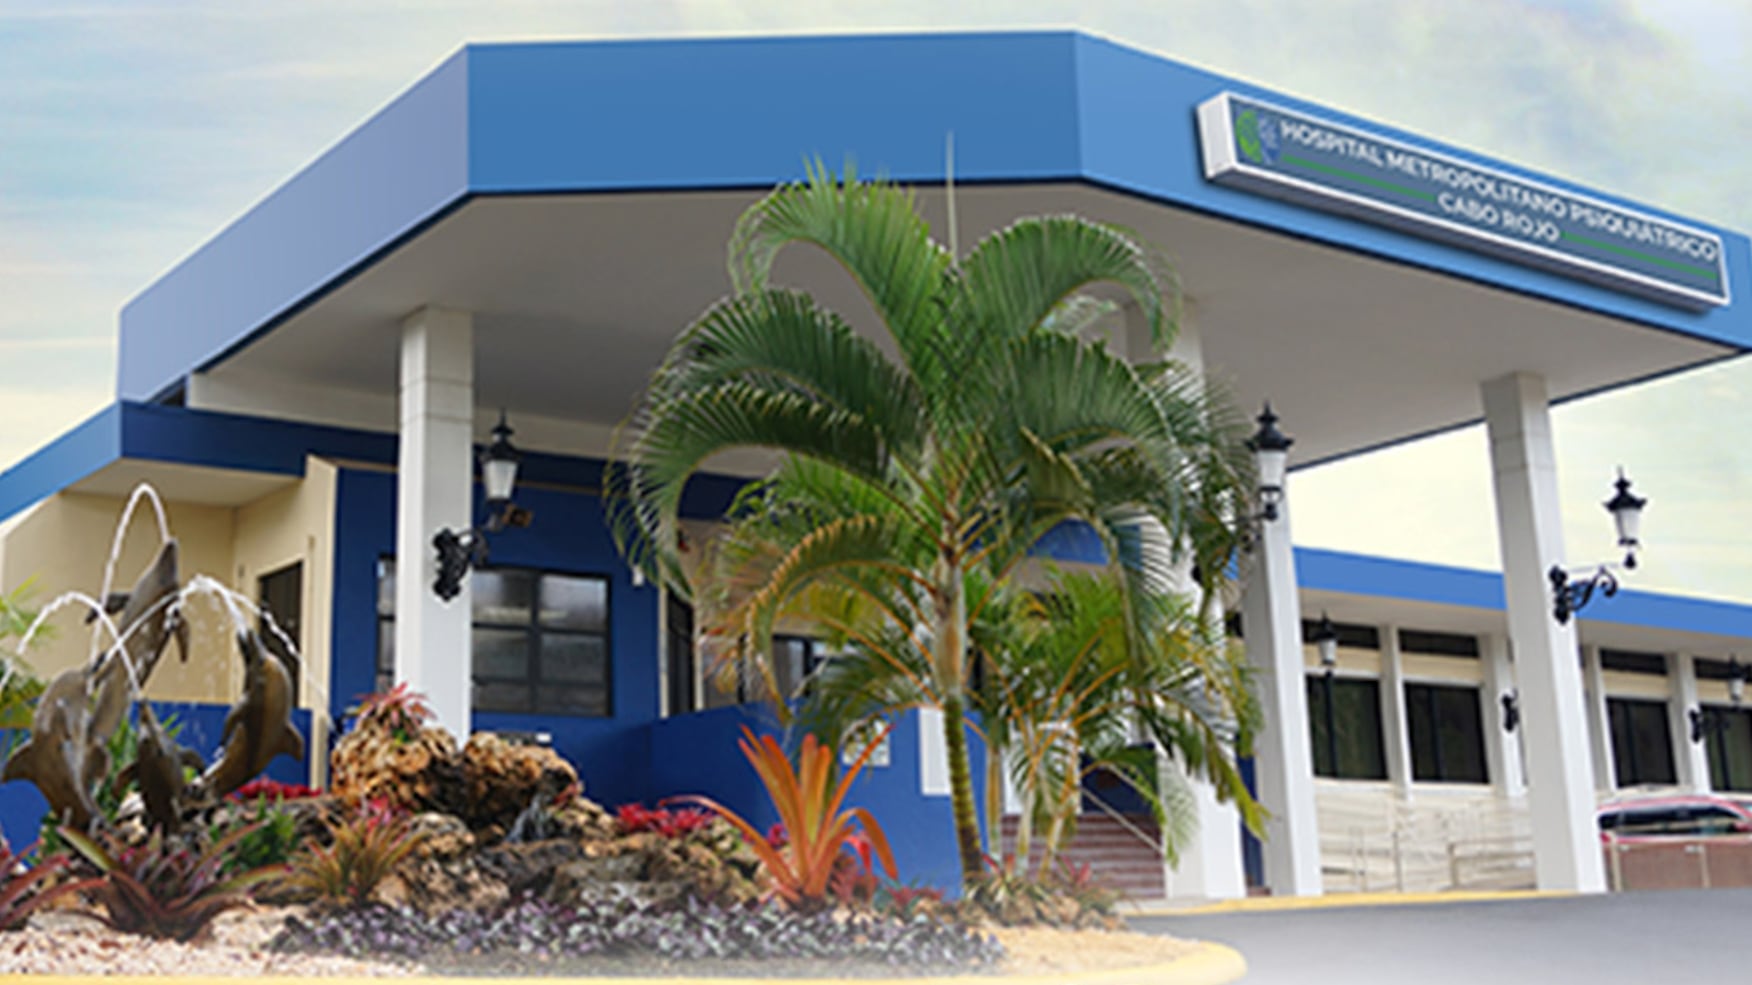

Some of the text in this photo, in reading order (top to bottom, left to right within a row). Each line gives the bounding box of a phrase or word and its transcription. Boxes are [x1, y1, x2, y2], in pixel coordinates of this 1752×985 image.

[1279, 119, 1383, 167] HOSPITAL
[1387, 151, 1567, 218] METROPOLITANO
[1438, 193, 1559, 241] CABO ROJO
